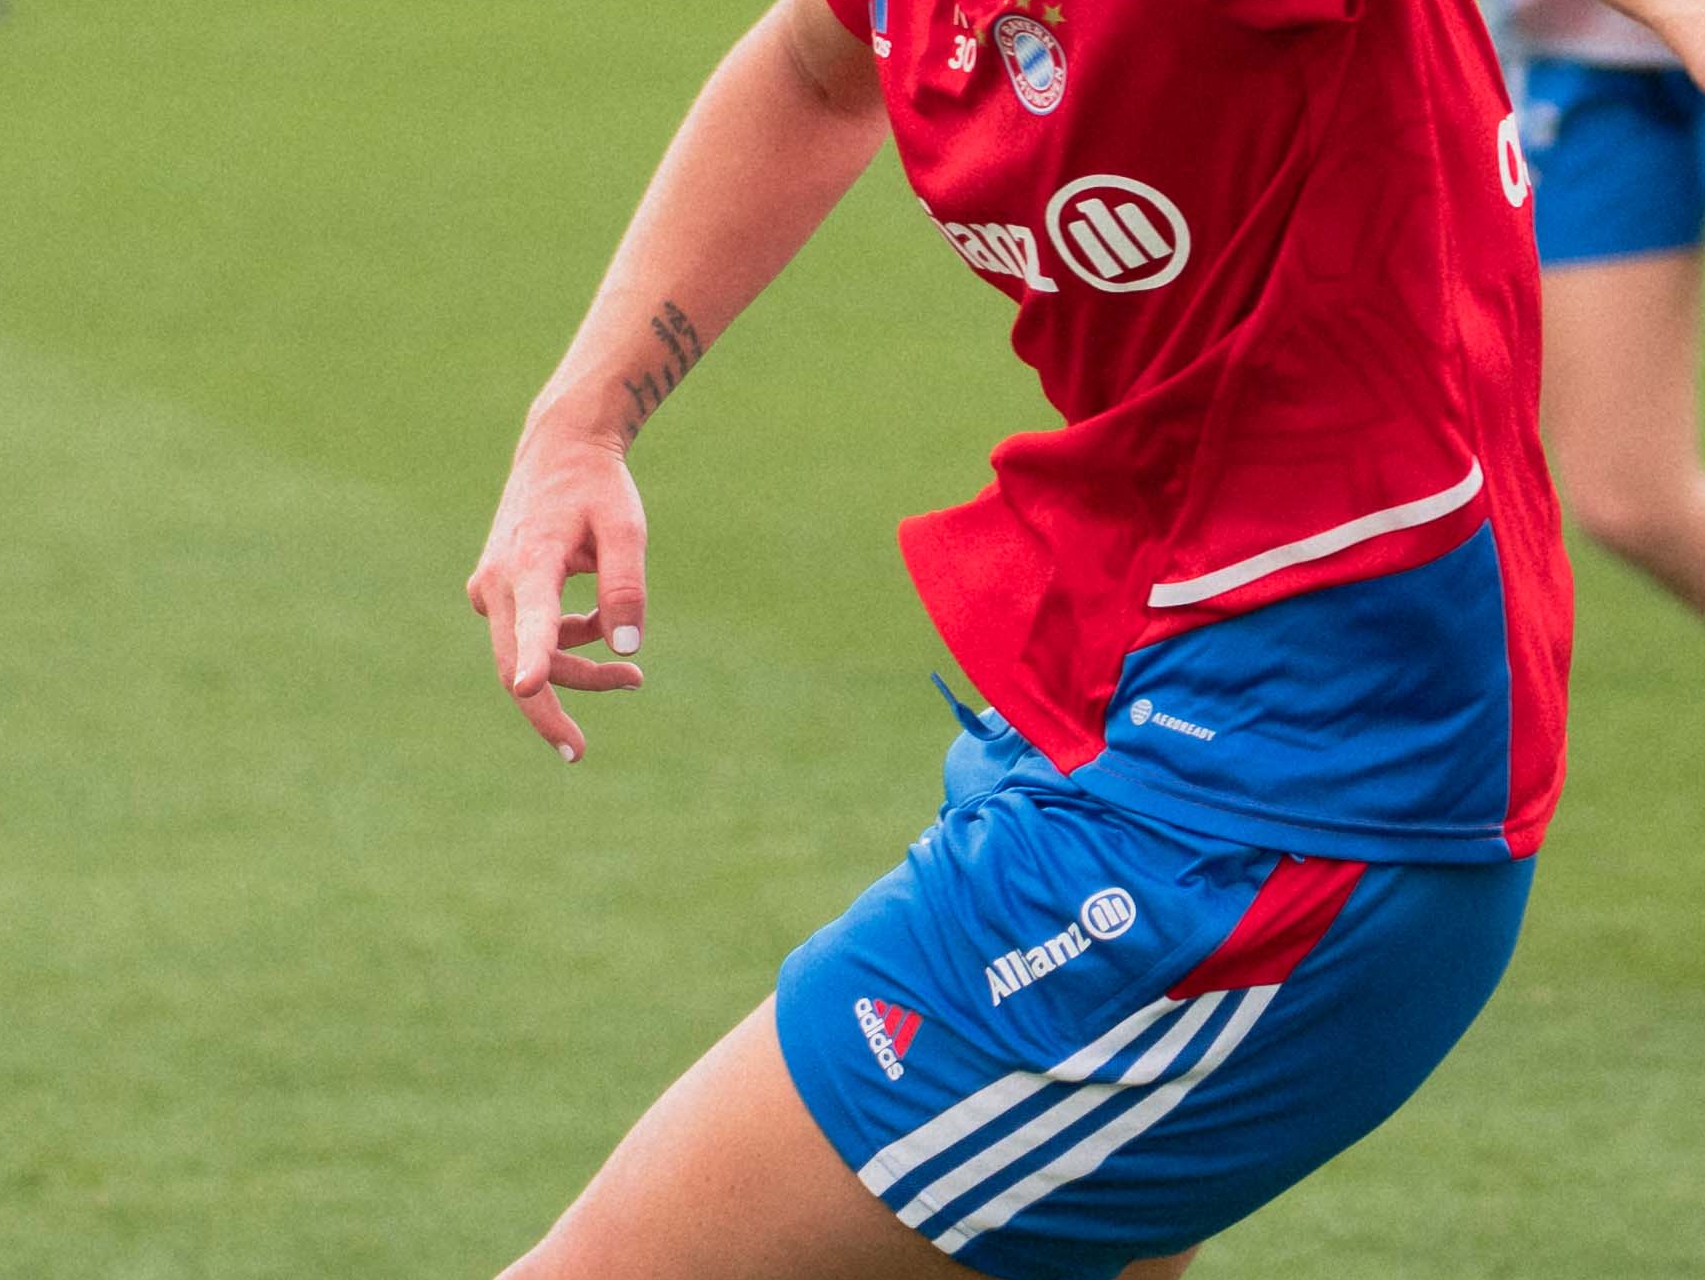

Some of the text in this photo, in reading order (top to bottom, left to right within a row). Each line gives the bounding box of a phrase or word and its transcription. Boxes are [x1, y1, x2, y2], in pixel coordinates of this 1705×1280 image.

[947, 34, 978, 74] 30
[985, 921, 1092, 1008] Allianz
[854, 997, 905, 1081] adidas
